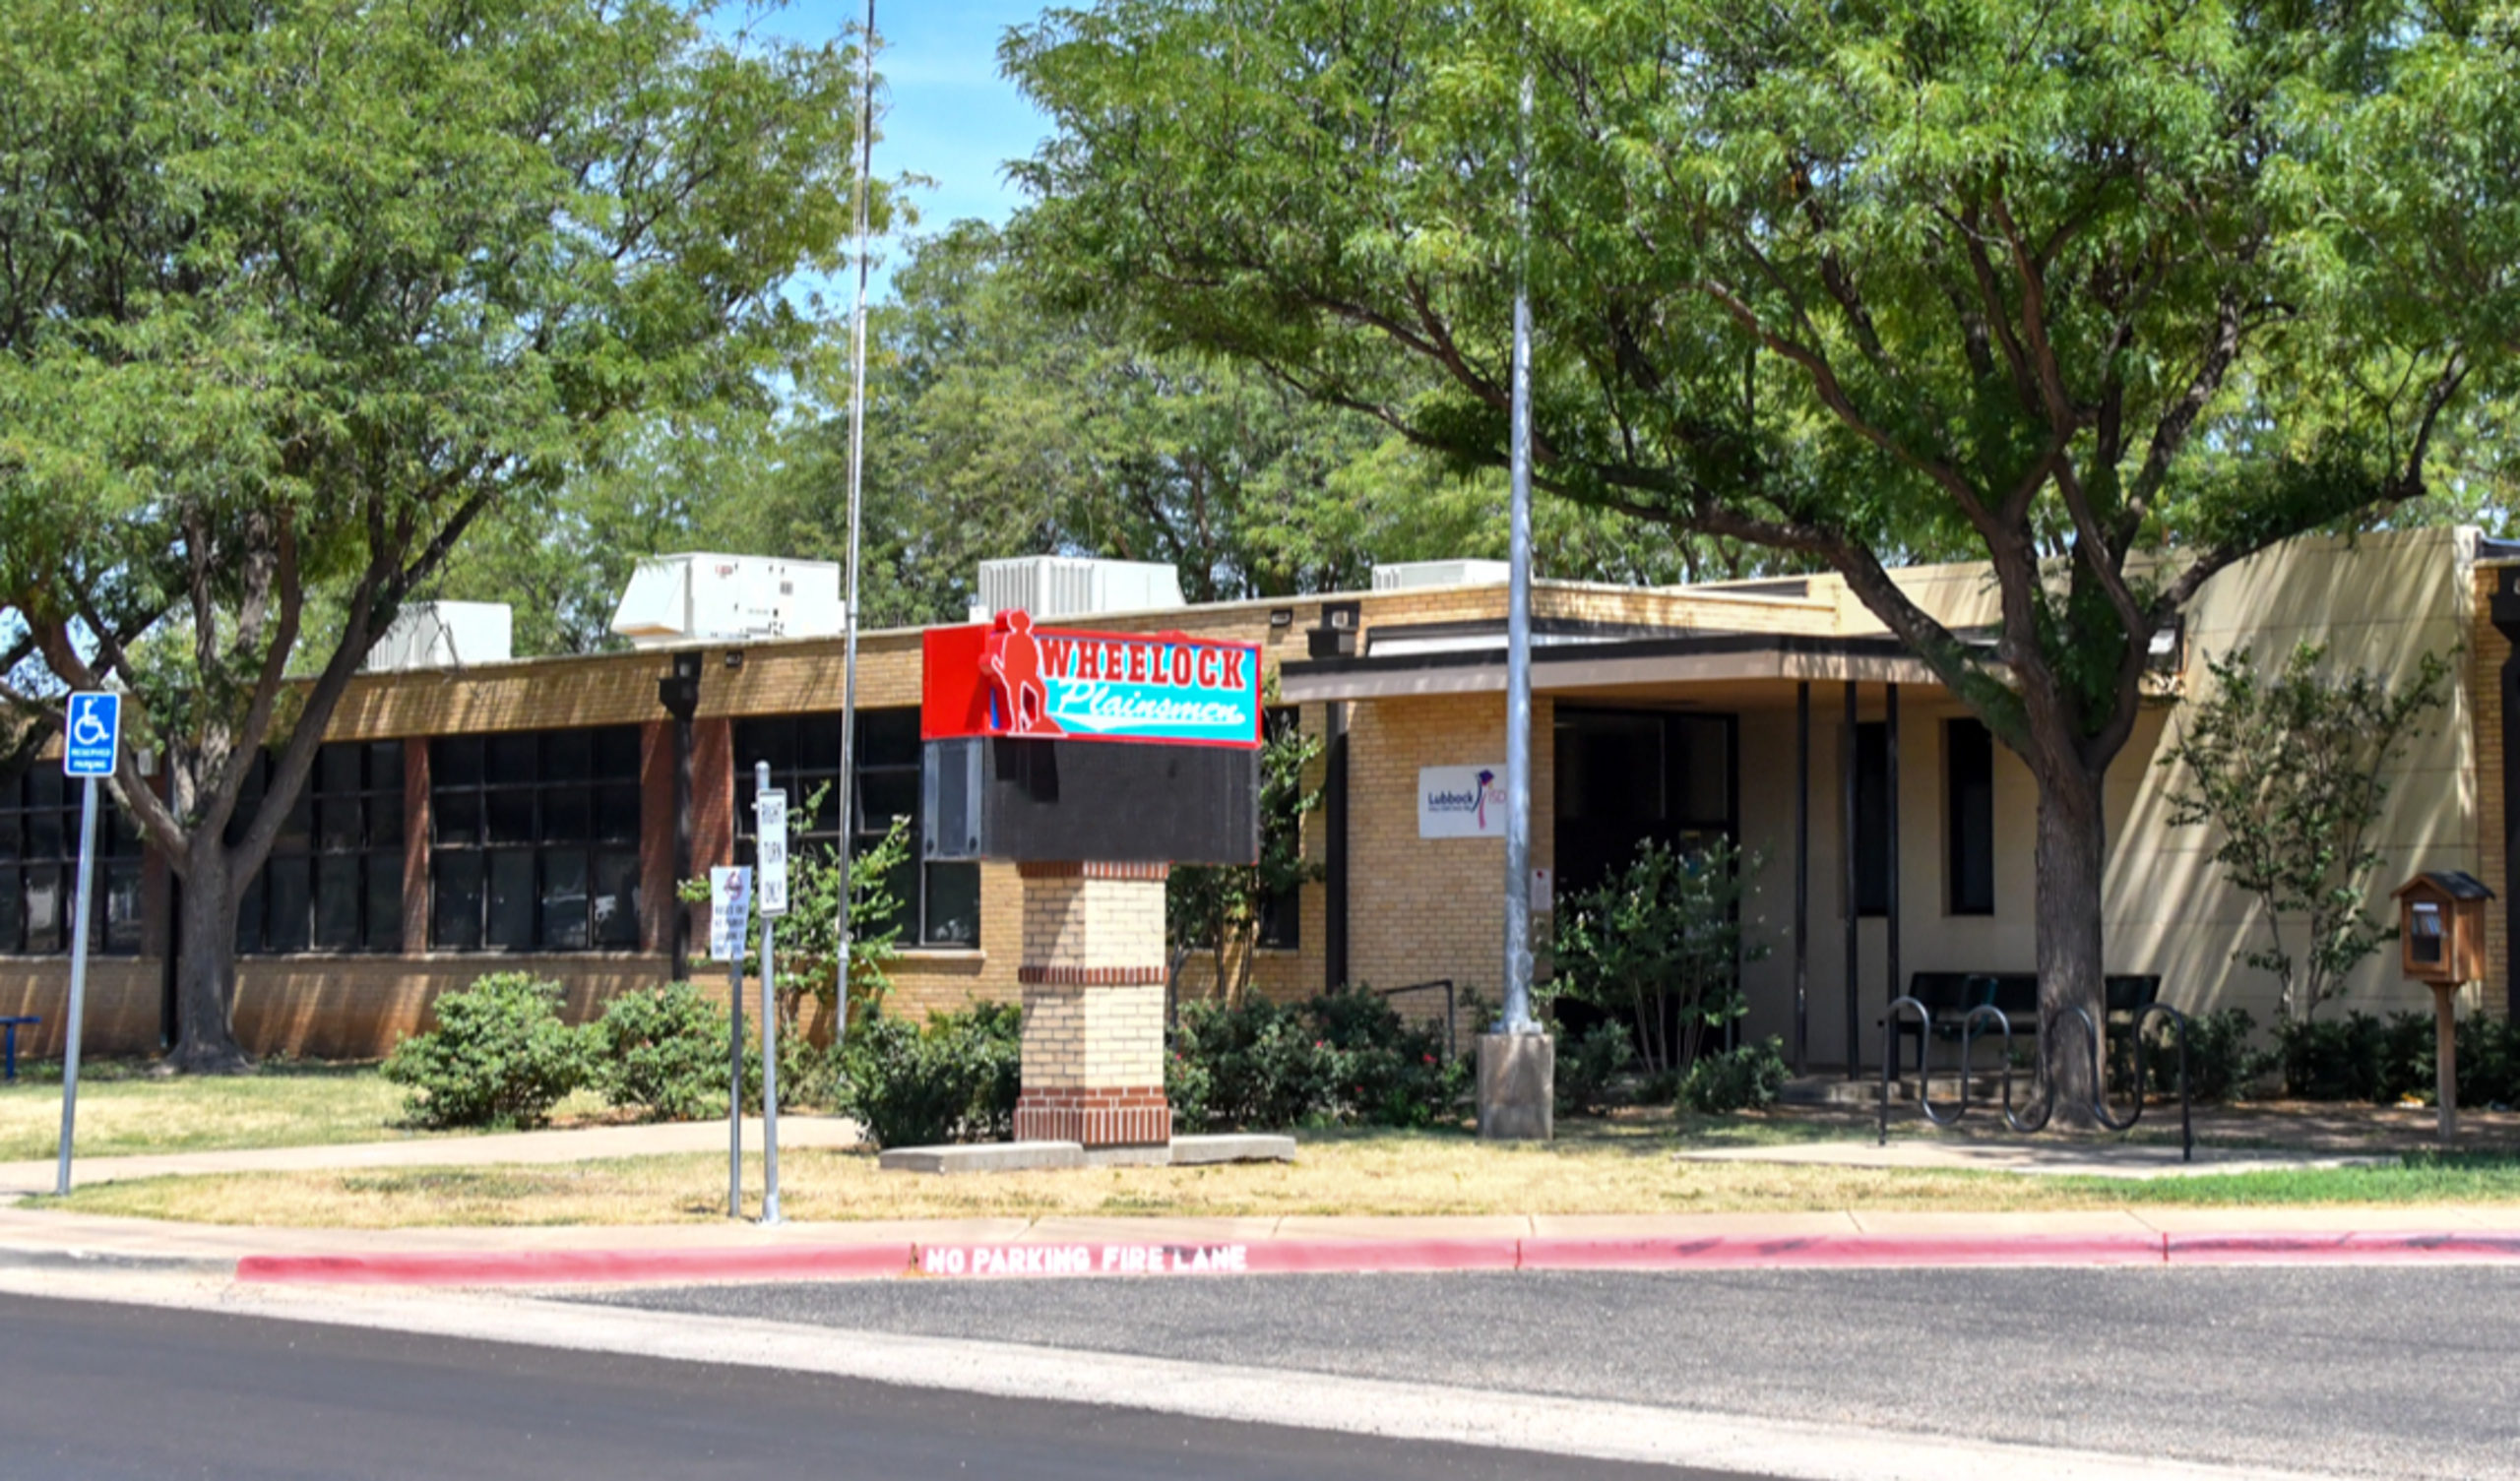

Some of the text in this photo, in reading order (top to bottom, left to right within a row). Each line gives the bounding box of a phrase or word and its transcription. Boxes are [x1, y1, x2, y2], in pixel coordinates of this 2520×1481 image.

[1037, 639, 1245, 690] WHEELOCK
[1056, 679, 1240, 723] Plainsmen
[1427, 789, 1474, 805] Lubbock
[764, 840, 784, 864] TURN
[764, 880, 784, 903] ONLY
[926, 1245, 1248, 1274] NO PARKING FIRE LANE
